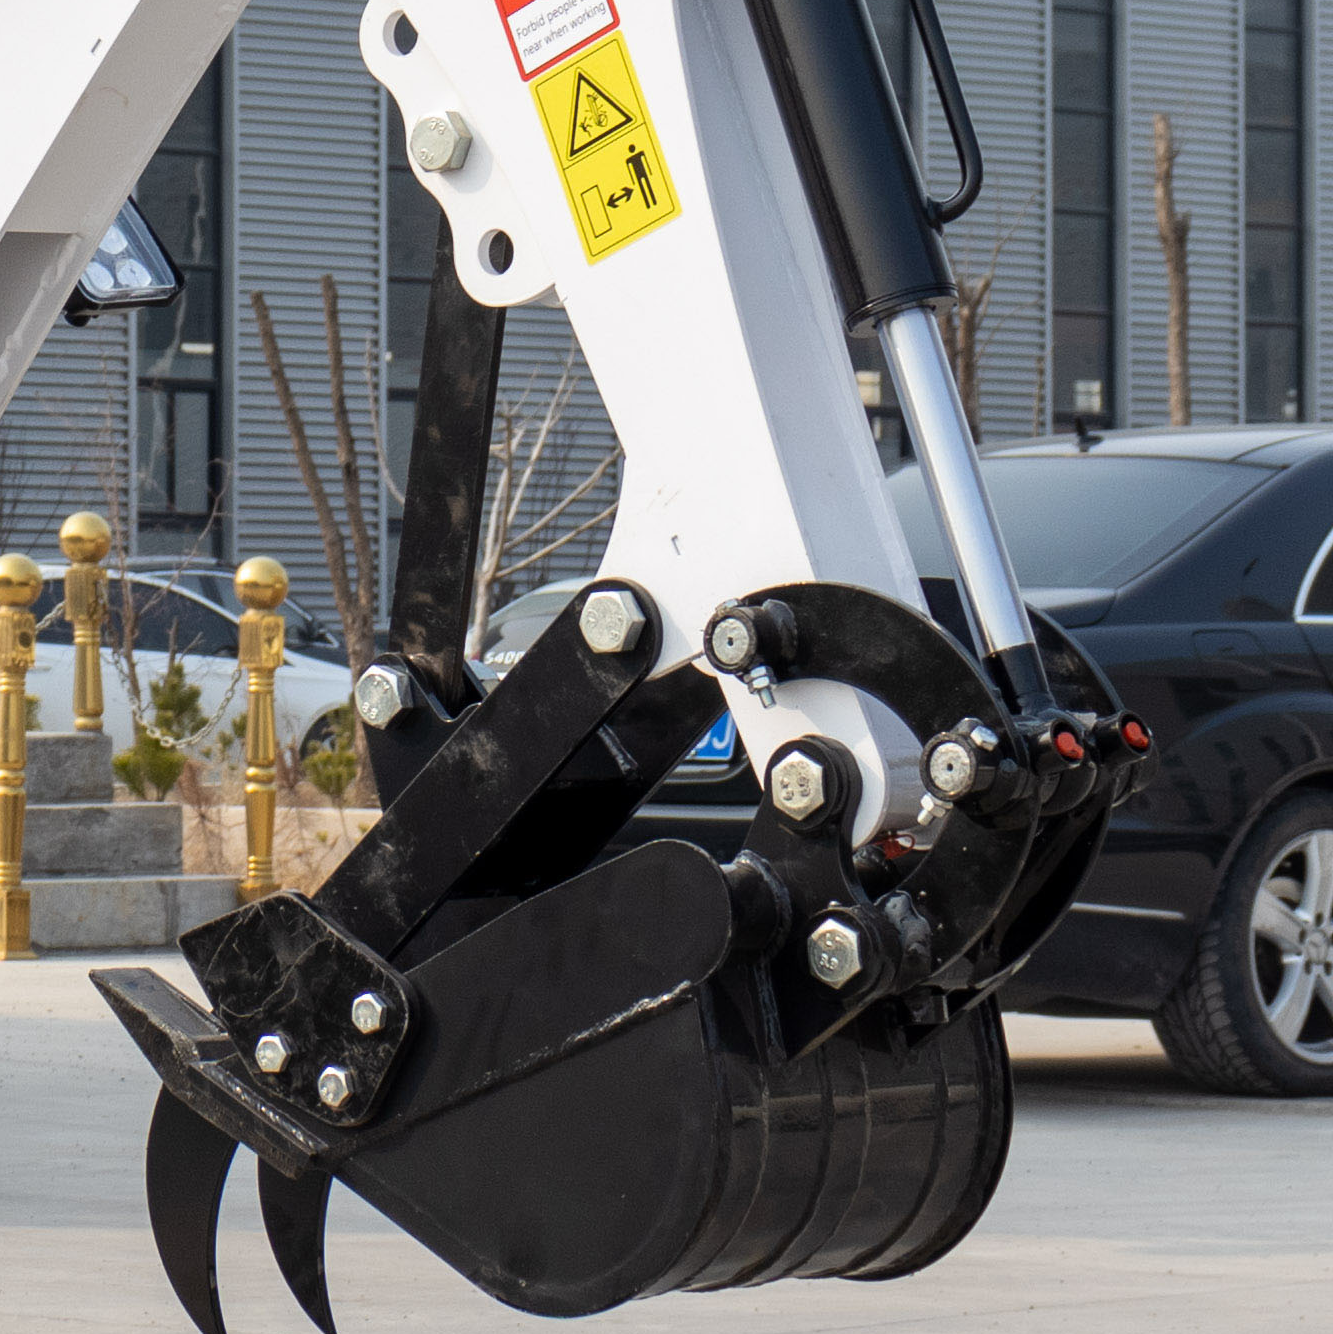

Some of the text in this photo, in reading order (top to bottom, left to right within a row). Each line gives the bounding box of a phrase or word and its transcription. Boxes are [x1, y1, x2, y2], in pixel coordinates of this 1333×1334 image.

[516, 13, 546, 40] Forbid
[523, 2, 608, 58] near when working
